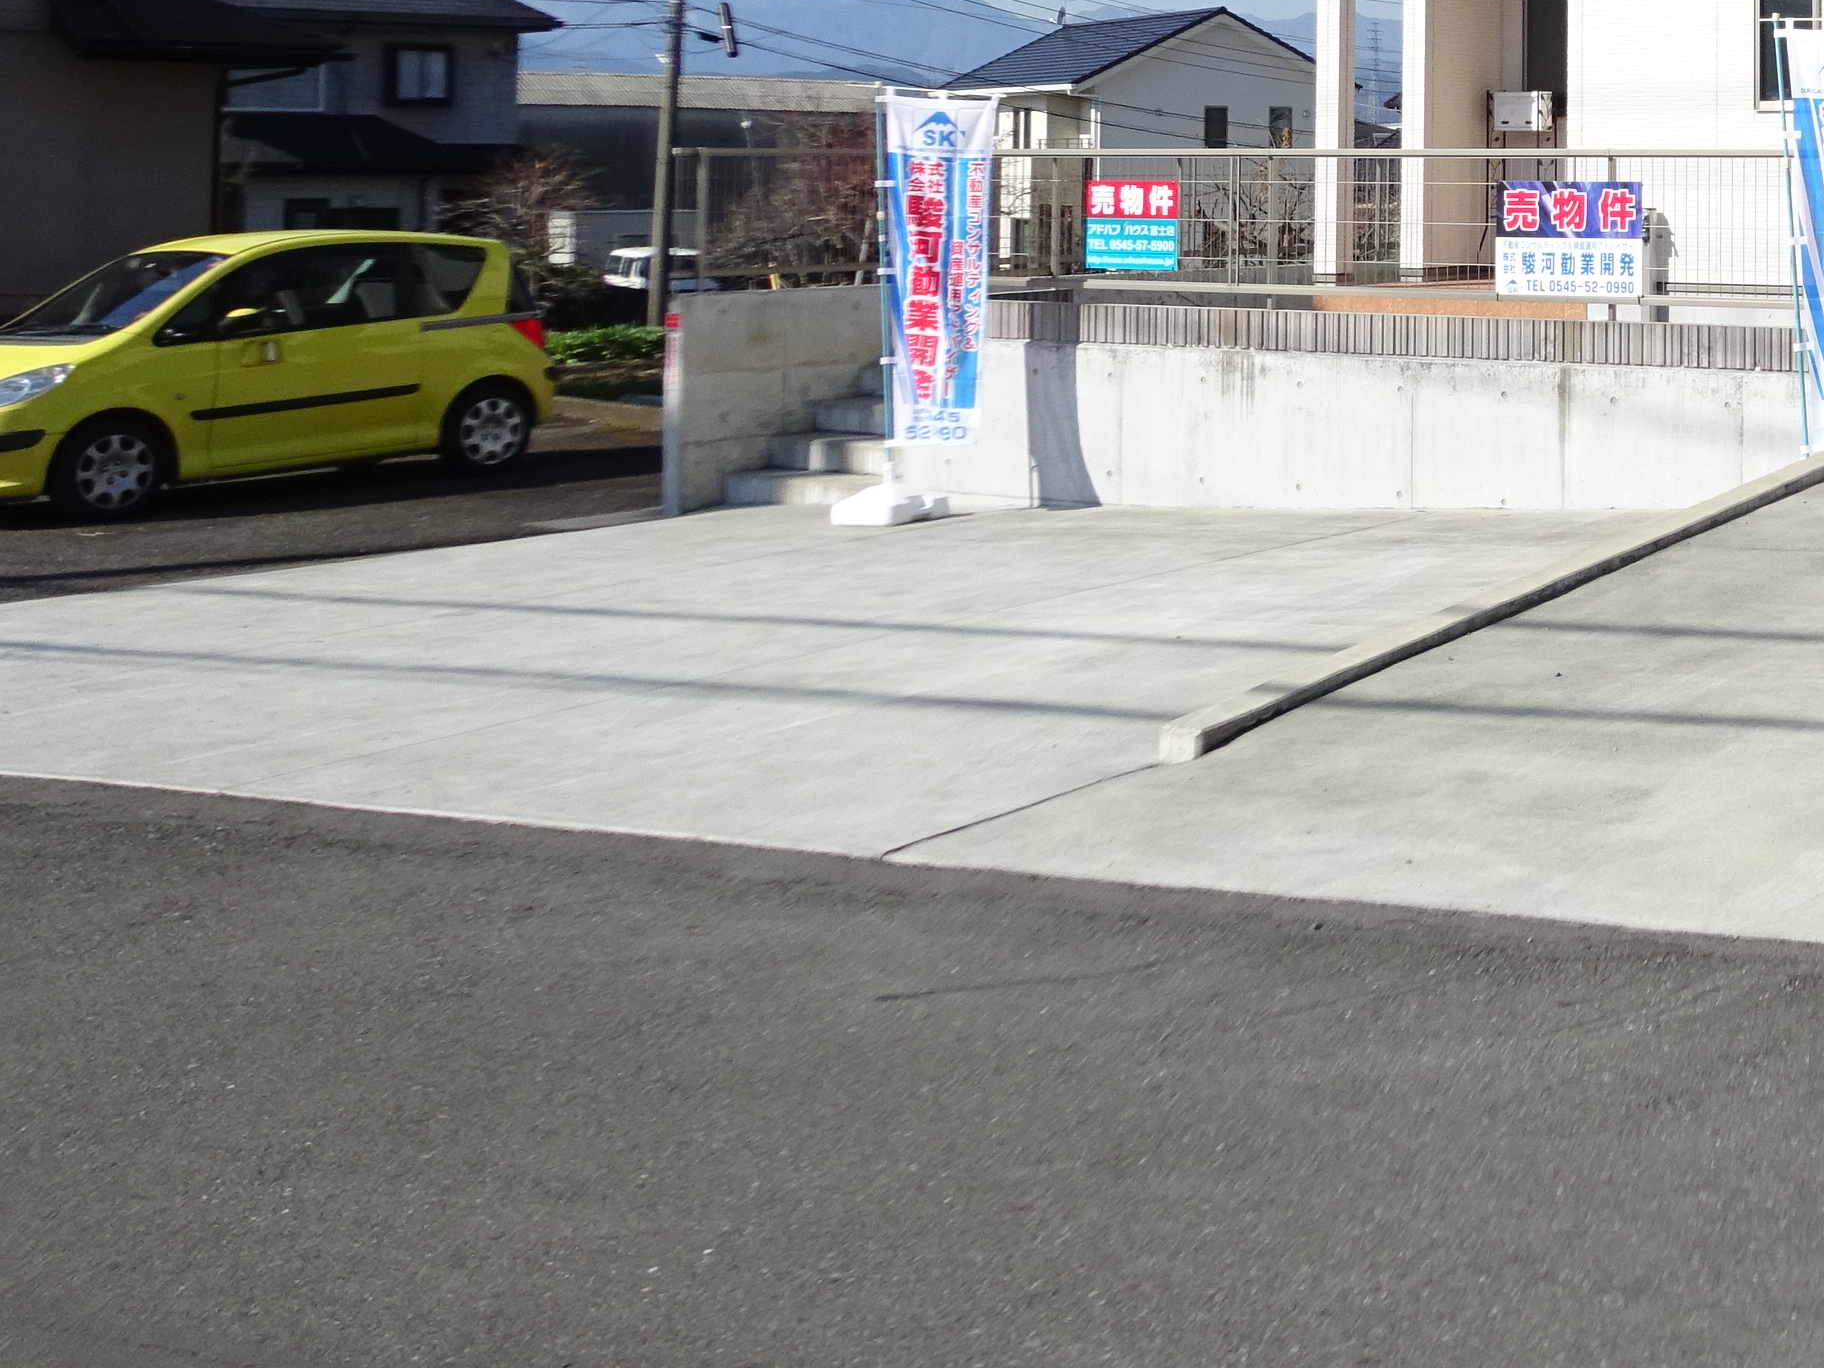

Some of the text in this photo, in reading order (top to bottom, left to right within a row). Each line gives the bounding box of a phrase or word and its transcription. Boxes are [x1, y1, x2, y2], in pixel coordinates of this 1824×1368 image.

[923, 129, 956, 147] SK
[1090, 184, 1174, 216] 売物件
[1504, 188, 1637, 232] 売物件
[1088, 239, 1109, 249] TEL
[1521, 251, 1635, 277] 駿河勧業開発
[1526, 280, 1635, 294] TEL 0545-52-0990
